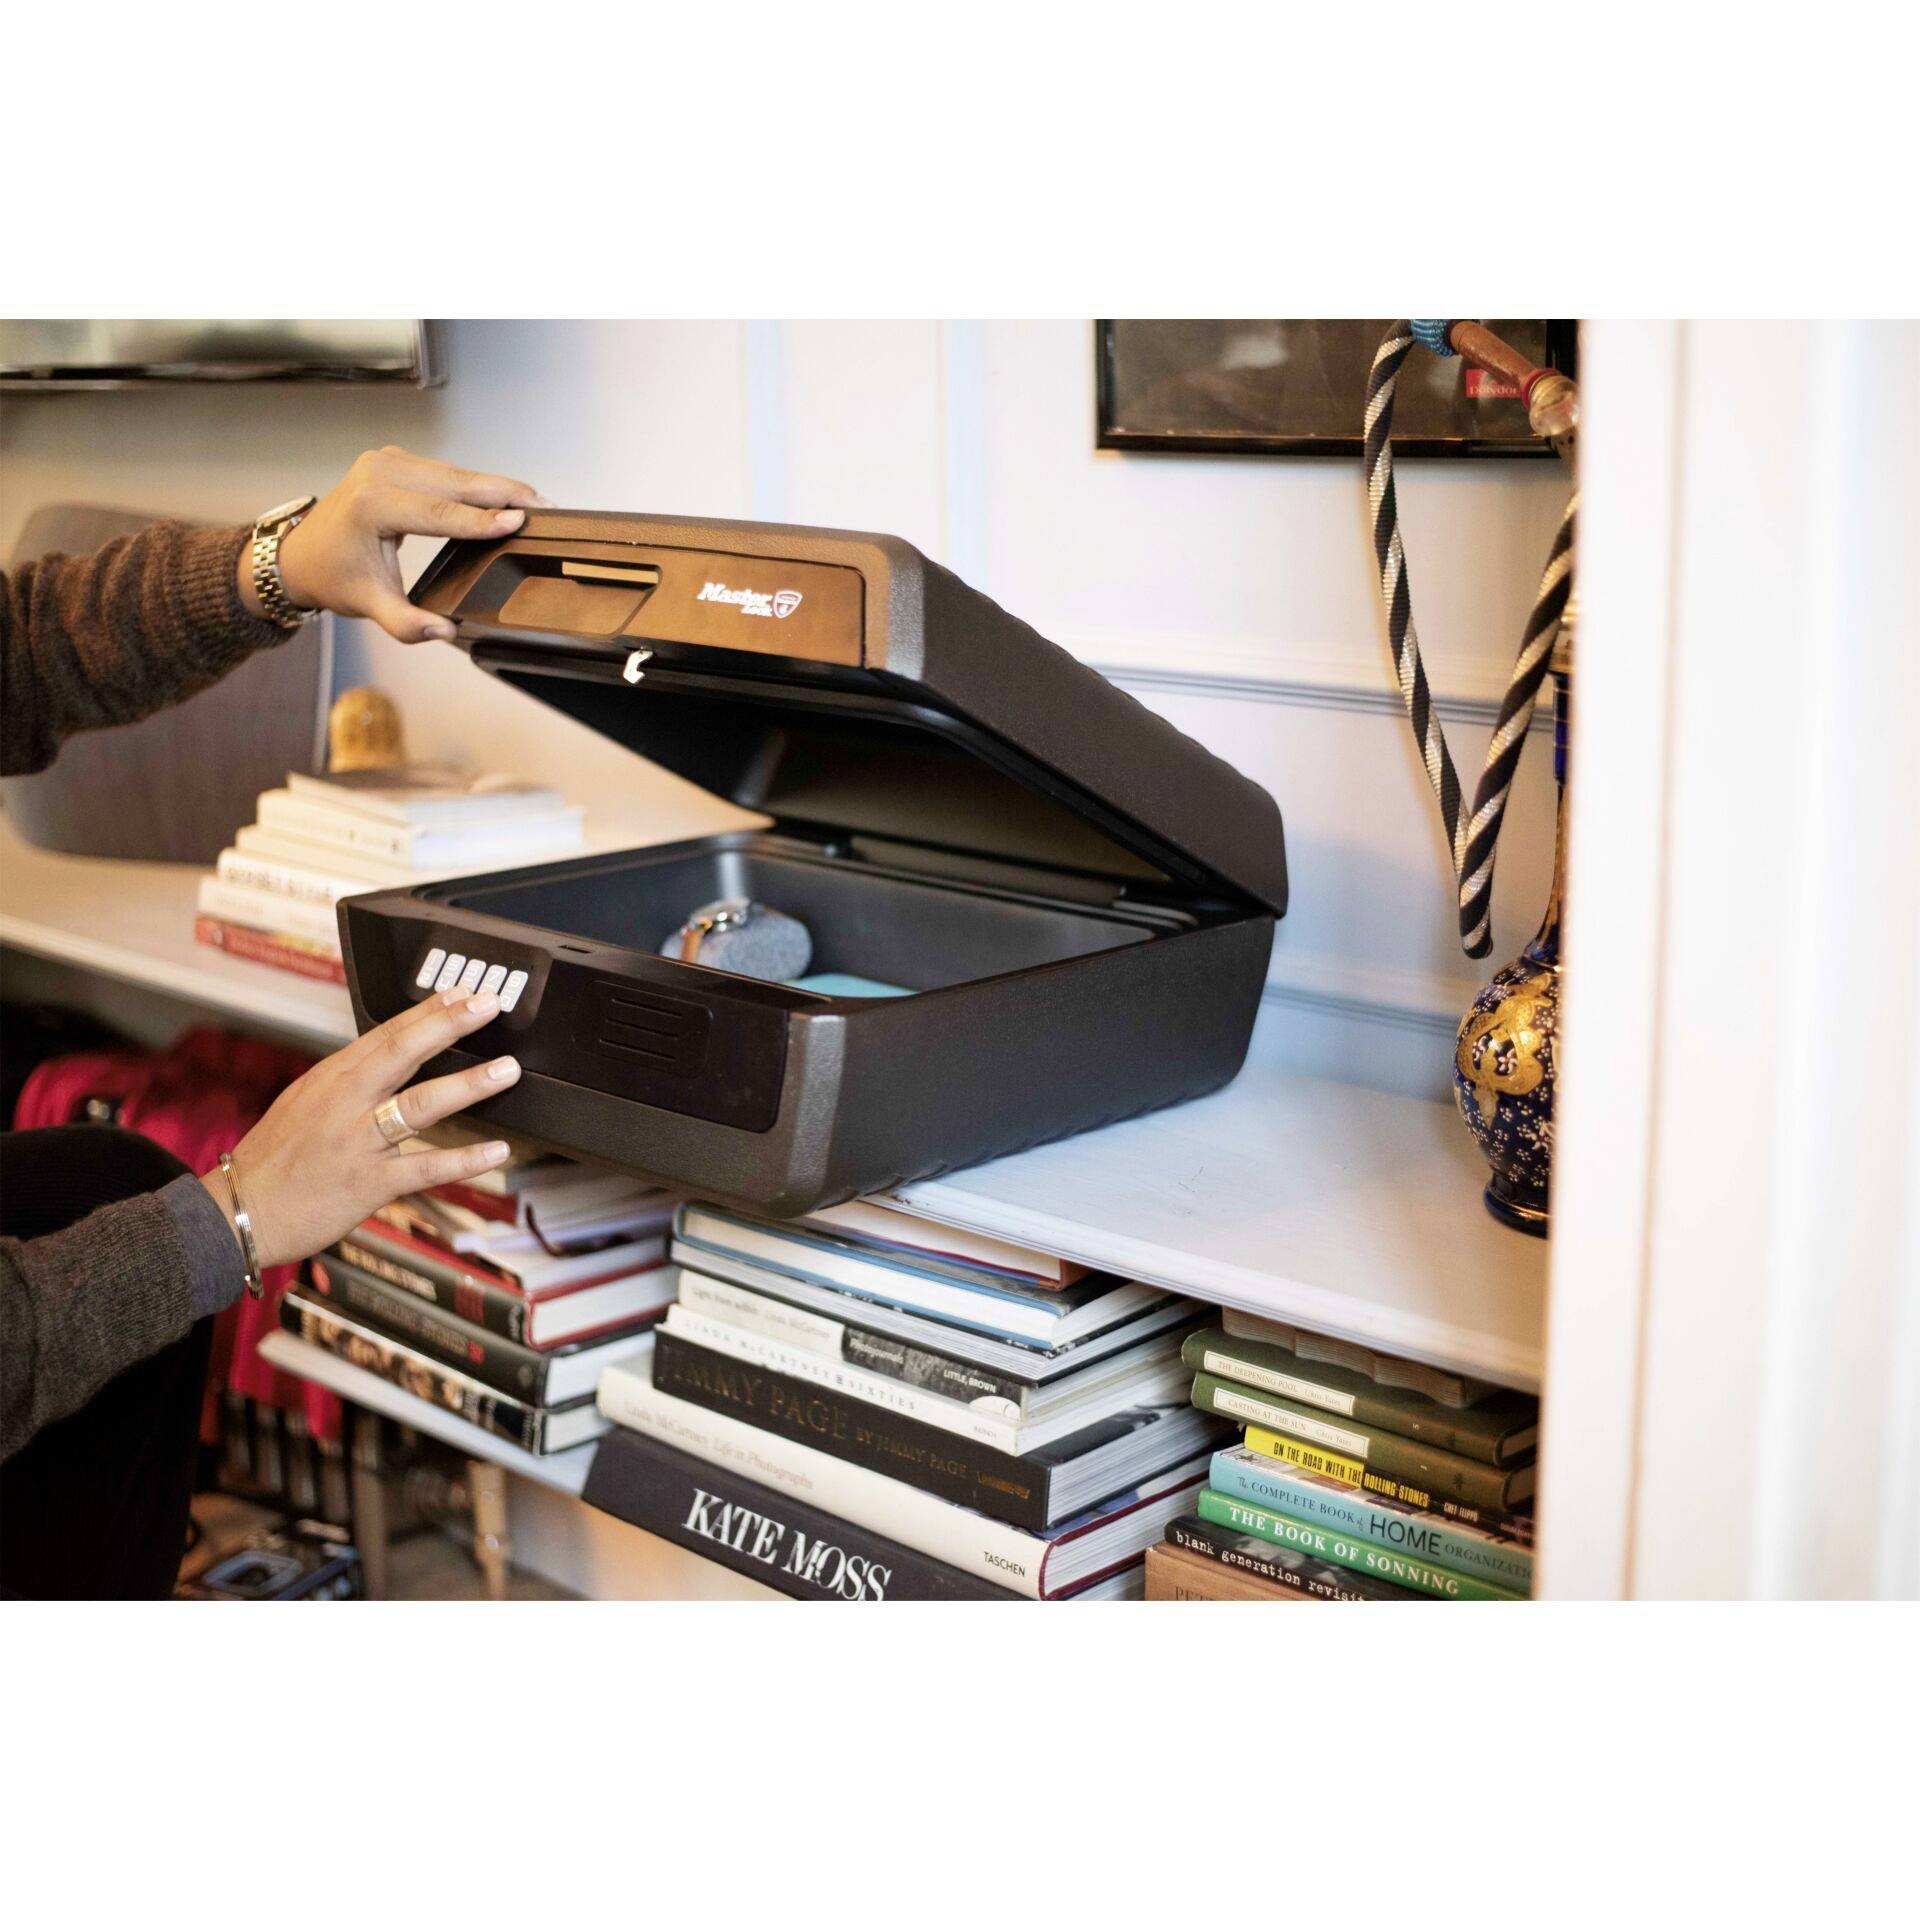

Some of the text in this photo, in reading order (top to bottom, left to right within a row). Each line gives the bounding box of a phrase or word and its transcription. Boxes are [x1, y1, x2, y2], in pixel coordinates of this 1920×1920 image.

[697, 582, 773, 606] Master
[741, 605, 773, 617] Lock
[943, 1369, 997, 1394] LITTLE, BROWN
[1217, 1360, 1233, 1373] THE
[1234, 1365, 1277, 1387] DEEPENING
[1278, 1379, 1298, 1392] POOL
[769, 1383, 848, 1440] PAGE
[928, 1452, 969, 1479] PAGE
[1227, 1400, 1261, 1417] CASTING
[1262, 1409, 1273, 1420] AT
[1274, 1412, 1289, 1426] THE
[1290, 1418, 1307, 1432] SUN
[746, 1450, 816, 1491] Photographs
[1273, 1442, 1431, 1509] ON THE ROAD WITH THE ROLLING STONES
[1251, 1481, 1317, 1512] COMPLETE
[1319, 1501, 1355, 1524] BOOK
[1369, 1513, 1443, 1556] HOME
[681, 1488, 893, 1601] KATE MOSS
[984, 1551, 1027, 1578] TASCHEN
[1175, 1531, 1215, 1556] blank
[1221, 1550, 1301, 1586] generation
[1229, 1506, 1460, 1595] THE BOOK OF SONNING
